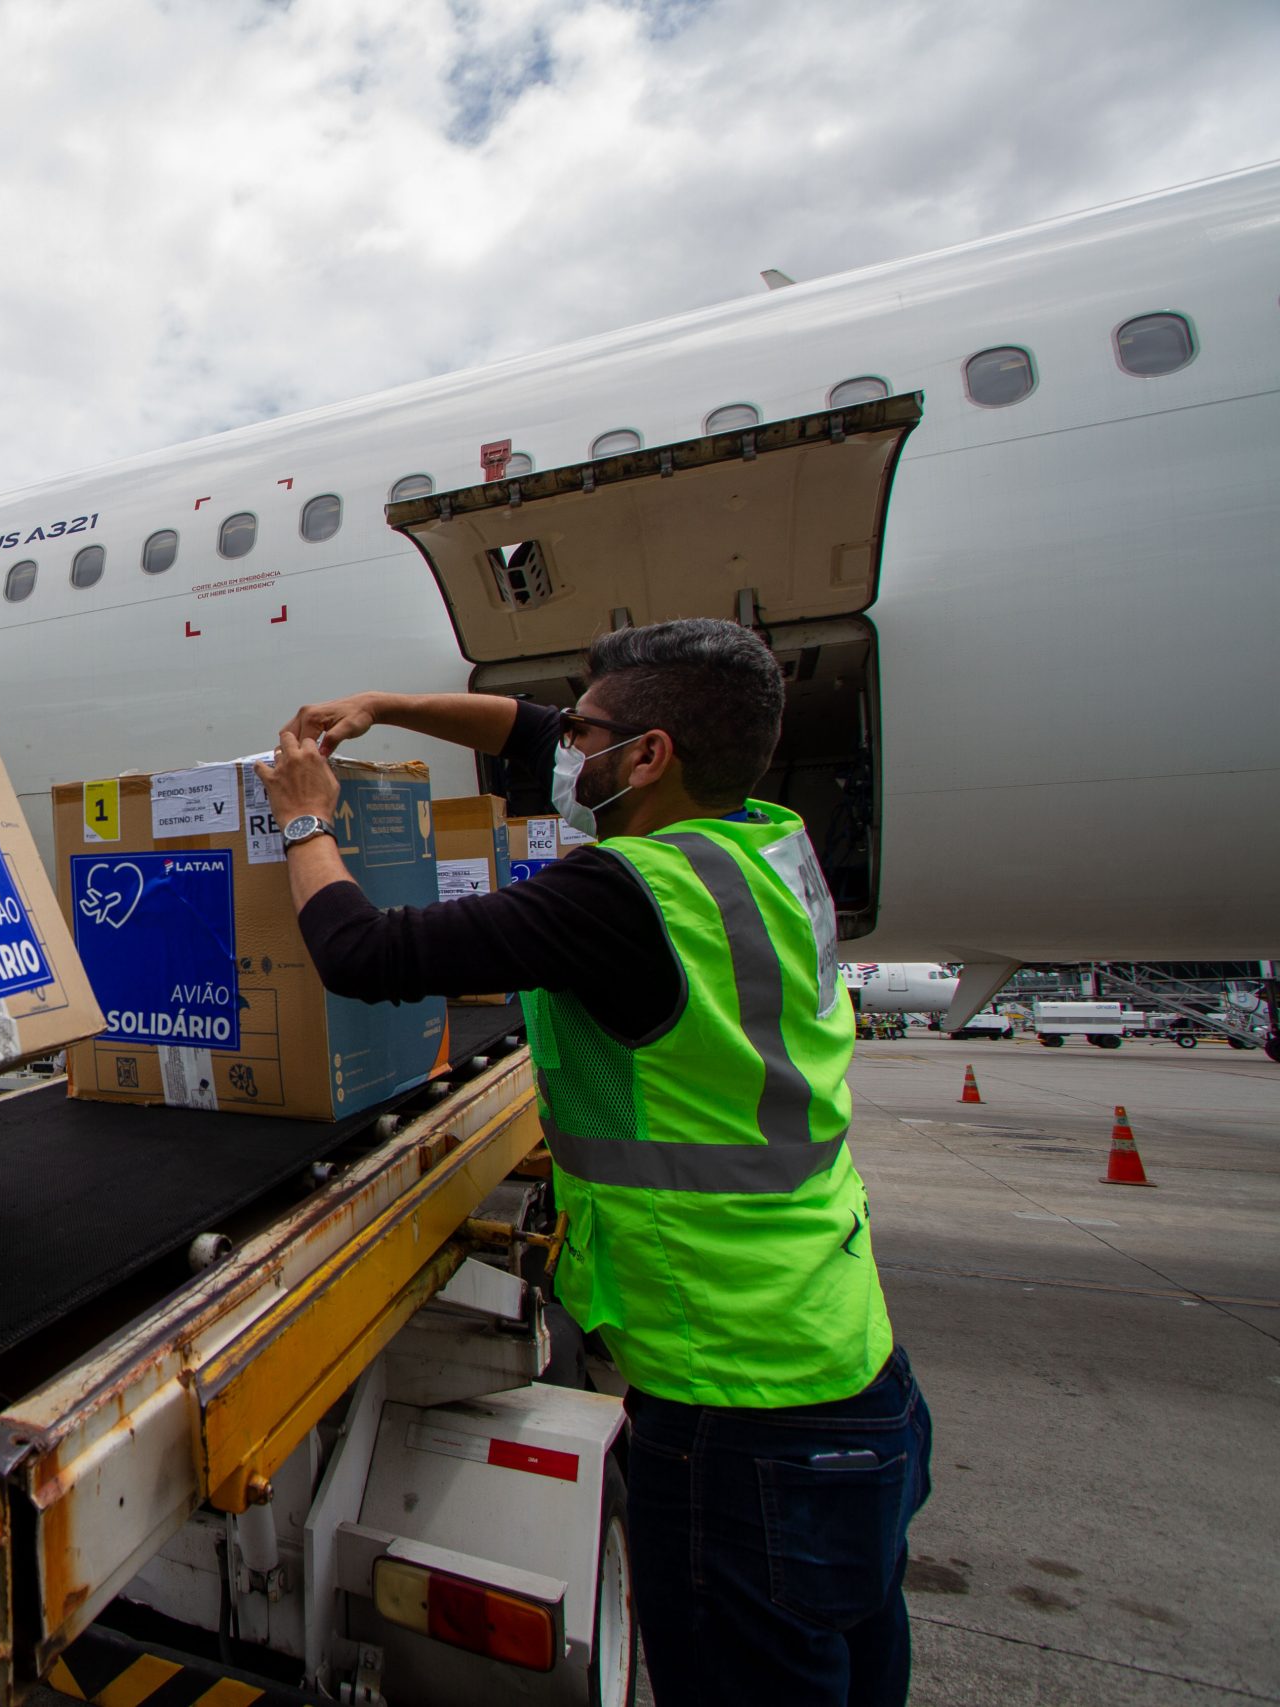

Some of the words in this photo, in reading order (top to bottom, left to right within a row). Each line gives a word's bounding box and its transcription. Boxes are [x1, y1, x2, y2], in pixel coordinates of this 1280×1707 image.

[24, 513, 99, 544] A321
[192, 583, 211, 592] CORTE
[213, 580, 227, 589] AQUI
[210, 587, 227, 597] HERE
[236, 580, 276, 592] EMERGENCY
[95, 798, 109, 822] 1
[213, 801, 224, 815] V
[159, 815, 193, 827] DESTINO:
[194, 814, 205, 823] PE
[249, 814, 281, 837] RE
[252, 840, 260, 849] R
[529, 840, 553, 849] REC
[176, 861, 226, 872] LATAM
[470, 881, 479, 890] V
[170, 981, 230, 1006] AVIÃO
[107, 1008, 231, 1041] SOLIDÁRIO
